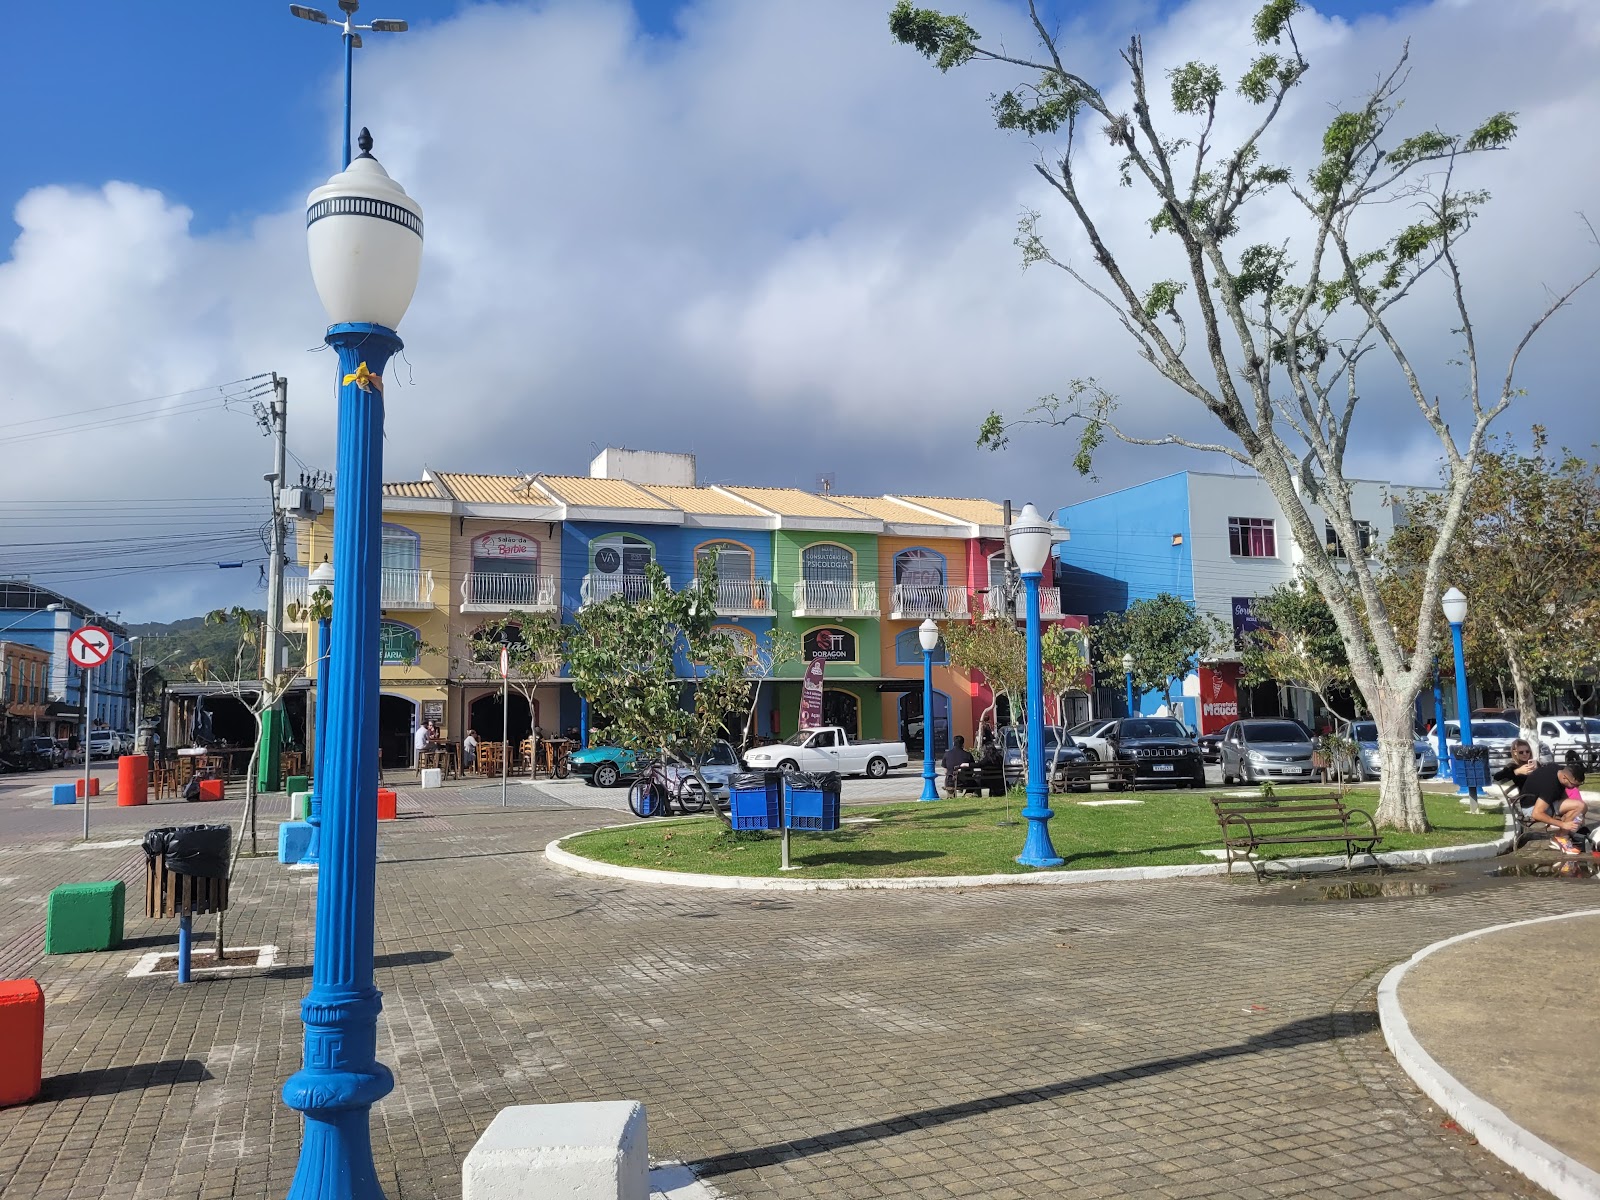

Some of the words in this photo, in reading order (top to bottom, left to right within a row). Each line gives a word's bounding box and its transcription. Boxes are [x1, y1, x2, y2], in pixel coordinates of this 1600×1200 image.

[497, 544, 527, 555] Barbie
[600, 552, 615, 563] VA
[807, 560, 848, 569] PSICOLOGIA
